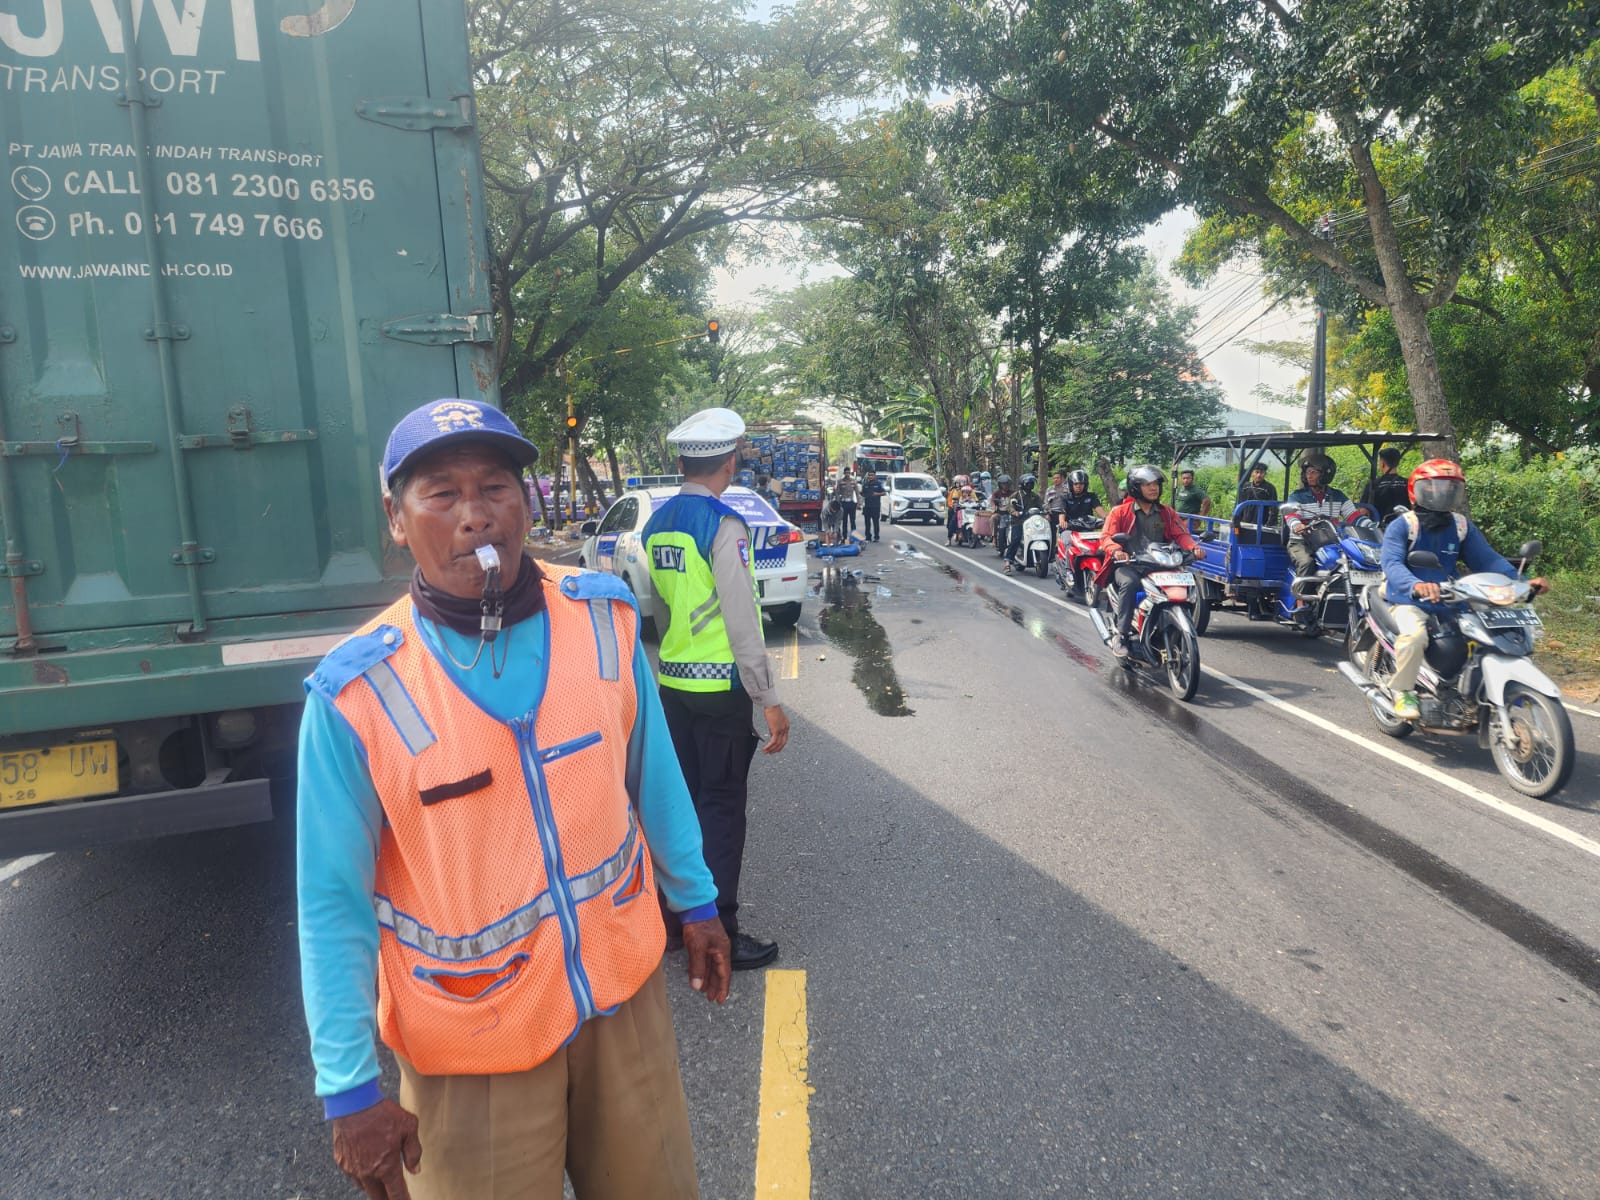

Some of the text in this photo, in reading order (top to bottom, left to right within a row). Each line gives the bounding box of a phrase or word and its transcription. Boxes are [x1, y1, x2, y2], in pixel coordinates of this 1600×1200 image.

[9, 143, 323, 167] PT JAWA TRAN INDAH TRANSPORT
[64, 170, 375, 201] CALL 081 2300 6356
[69, 211, 114, 236] Ph.
[190, 213, 245, 236] 749
[254, 214, 324, 240] 7666
